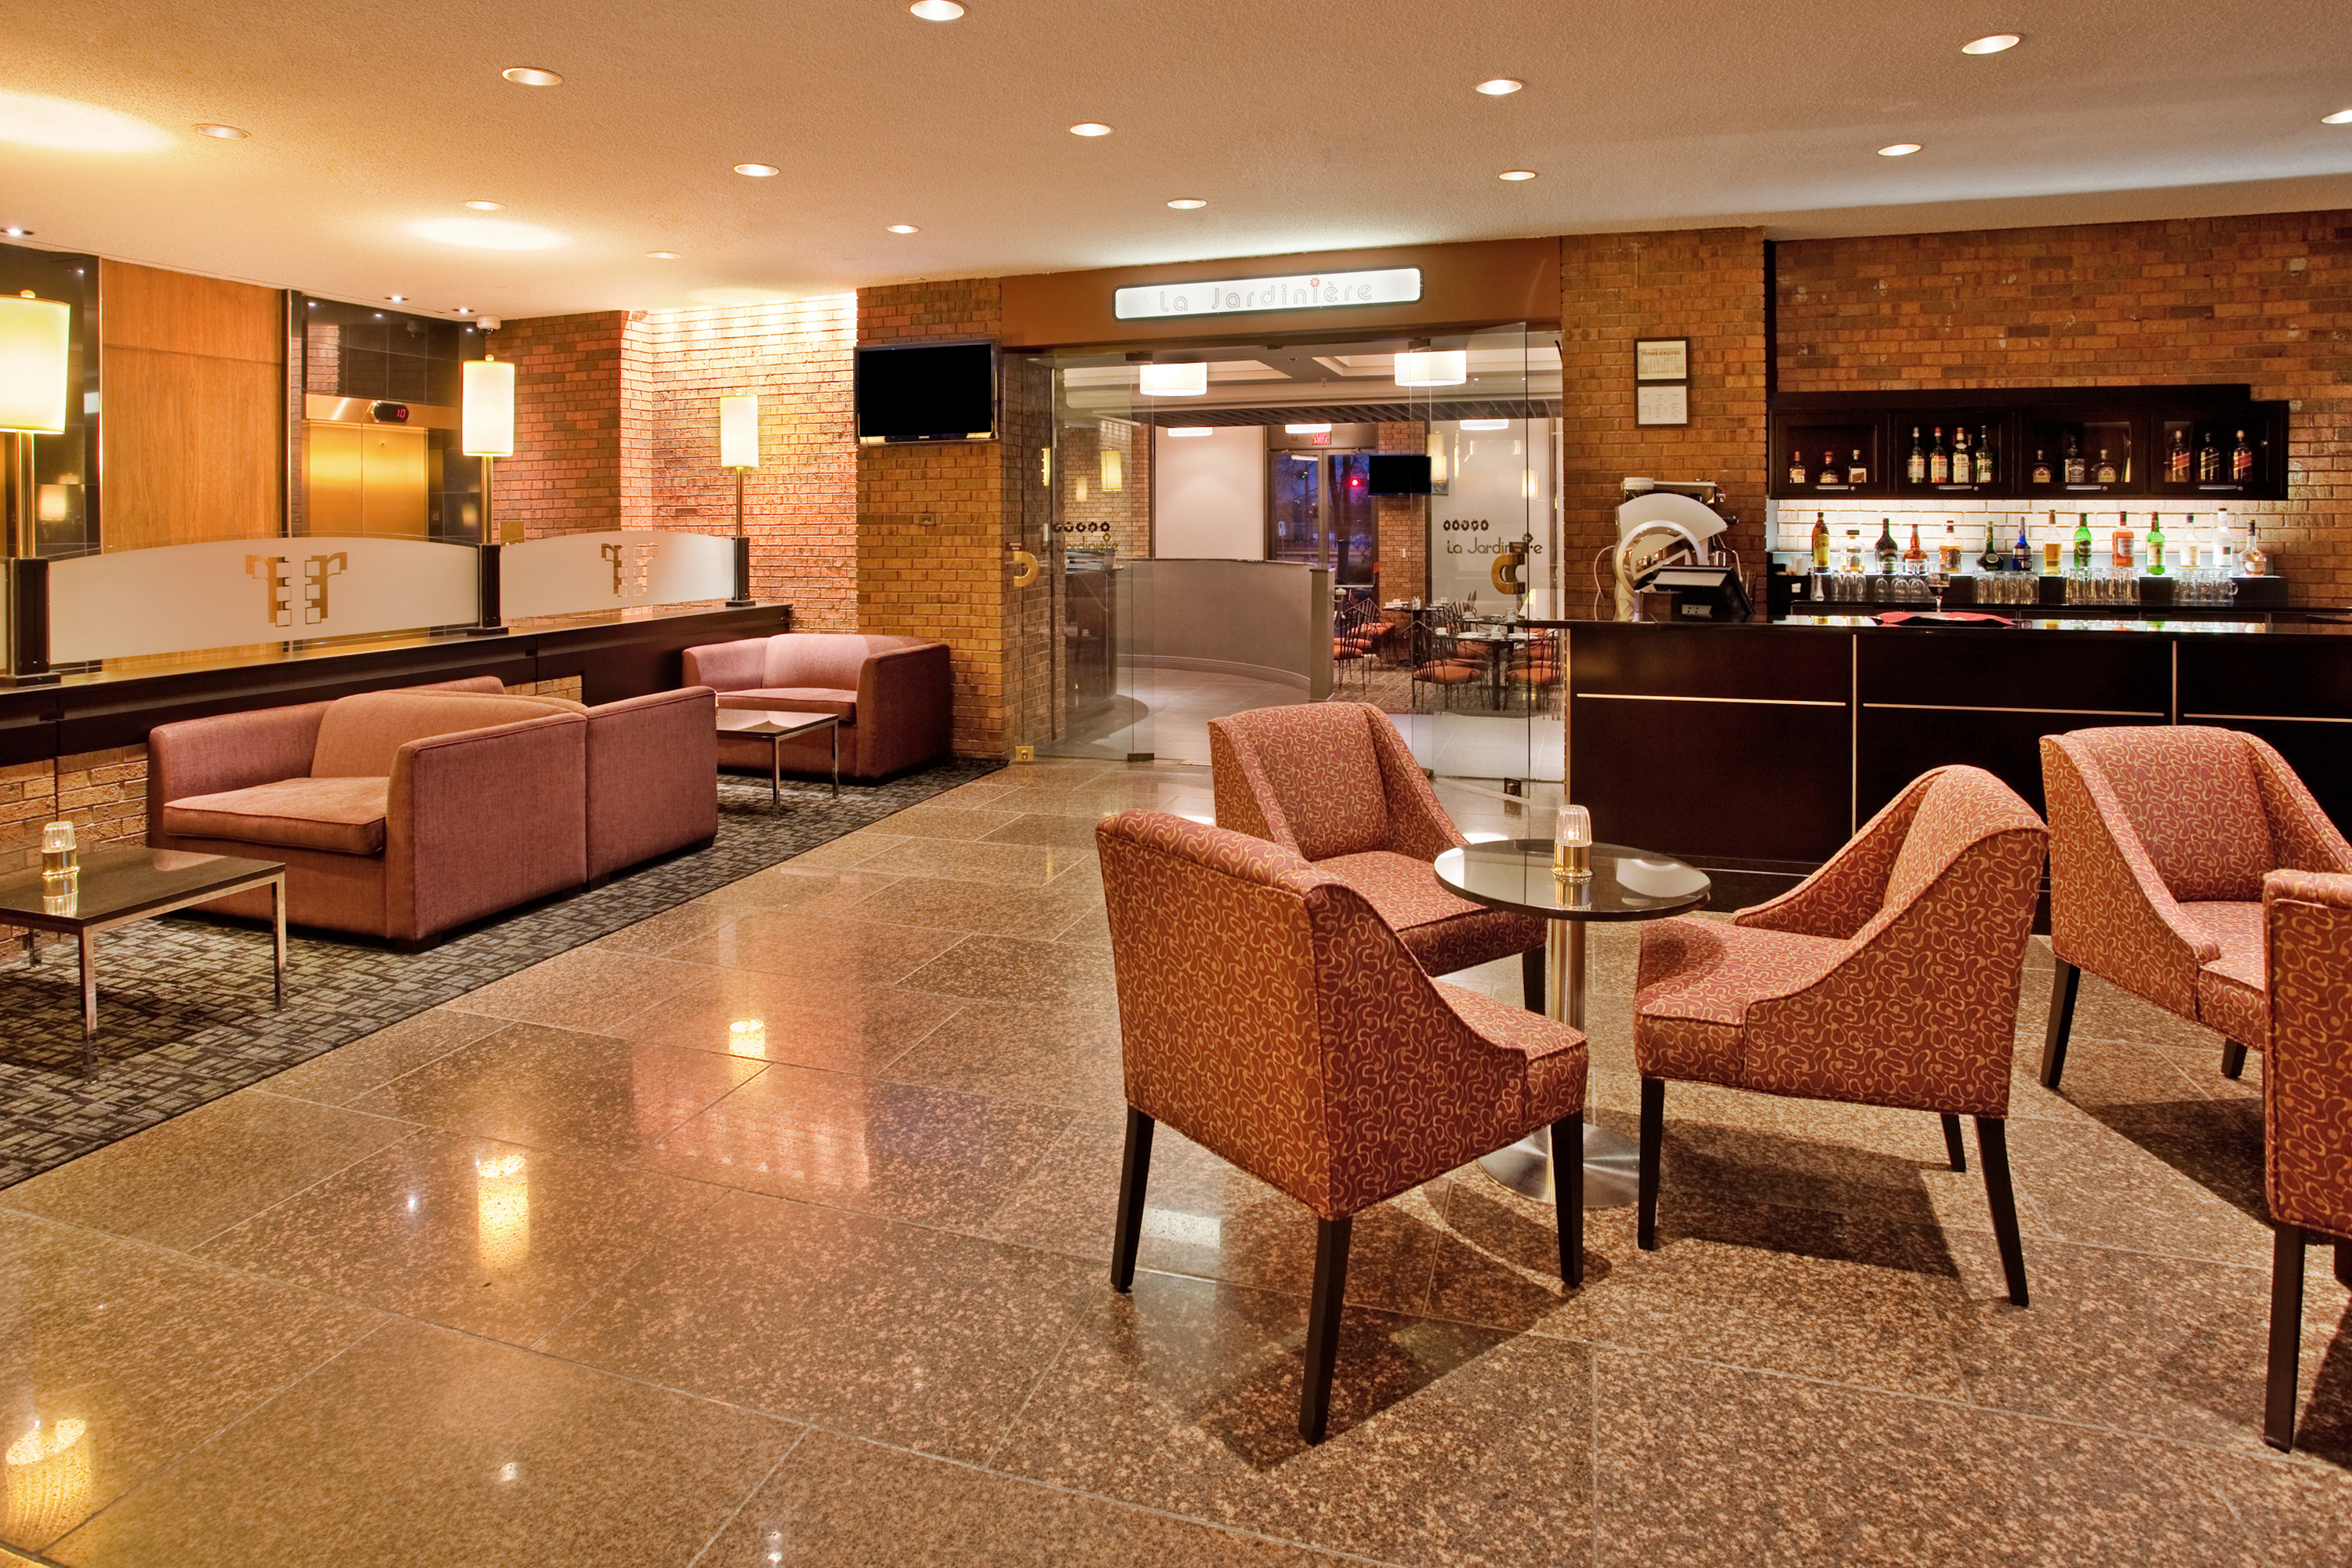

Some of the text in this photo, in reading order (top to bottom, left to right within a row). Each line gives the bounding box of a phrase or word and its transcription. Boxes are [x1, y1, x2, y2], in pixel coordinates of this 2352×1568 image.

[1160, 278, 1372, 312] La Jardinière
[397, 409, 406, 419] 10
[1446, 540, 1462, 554] La
